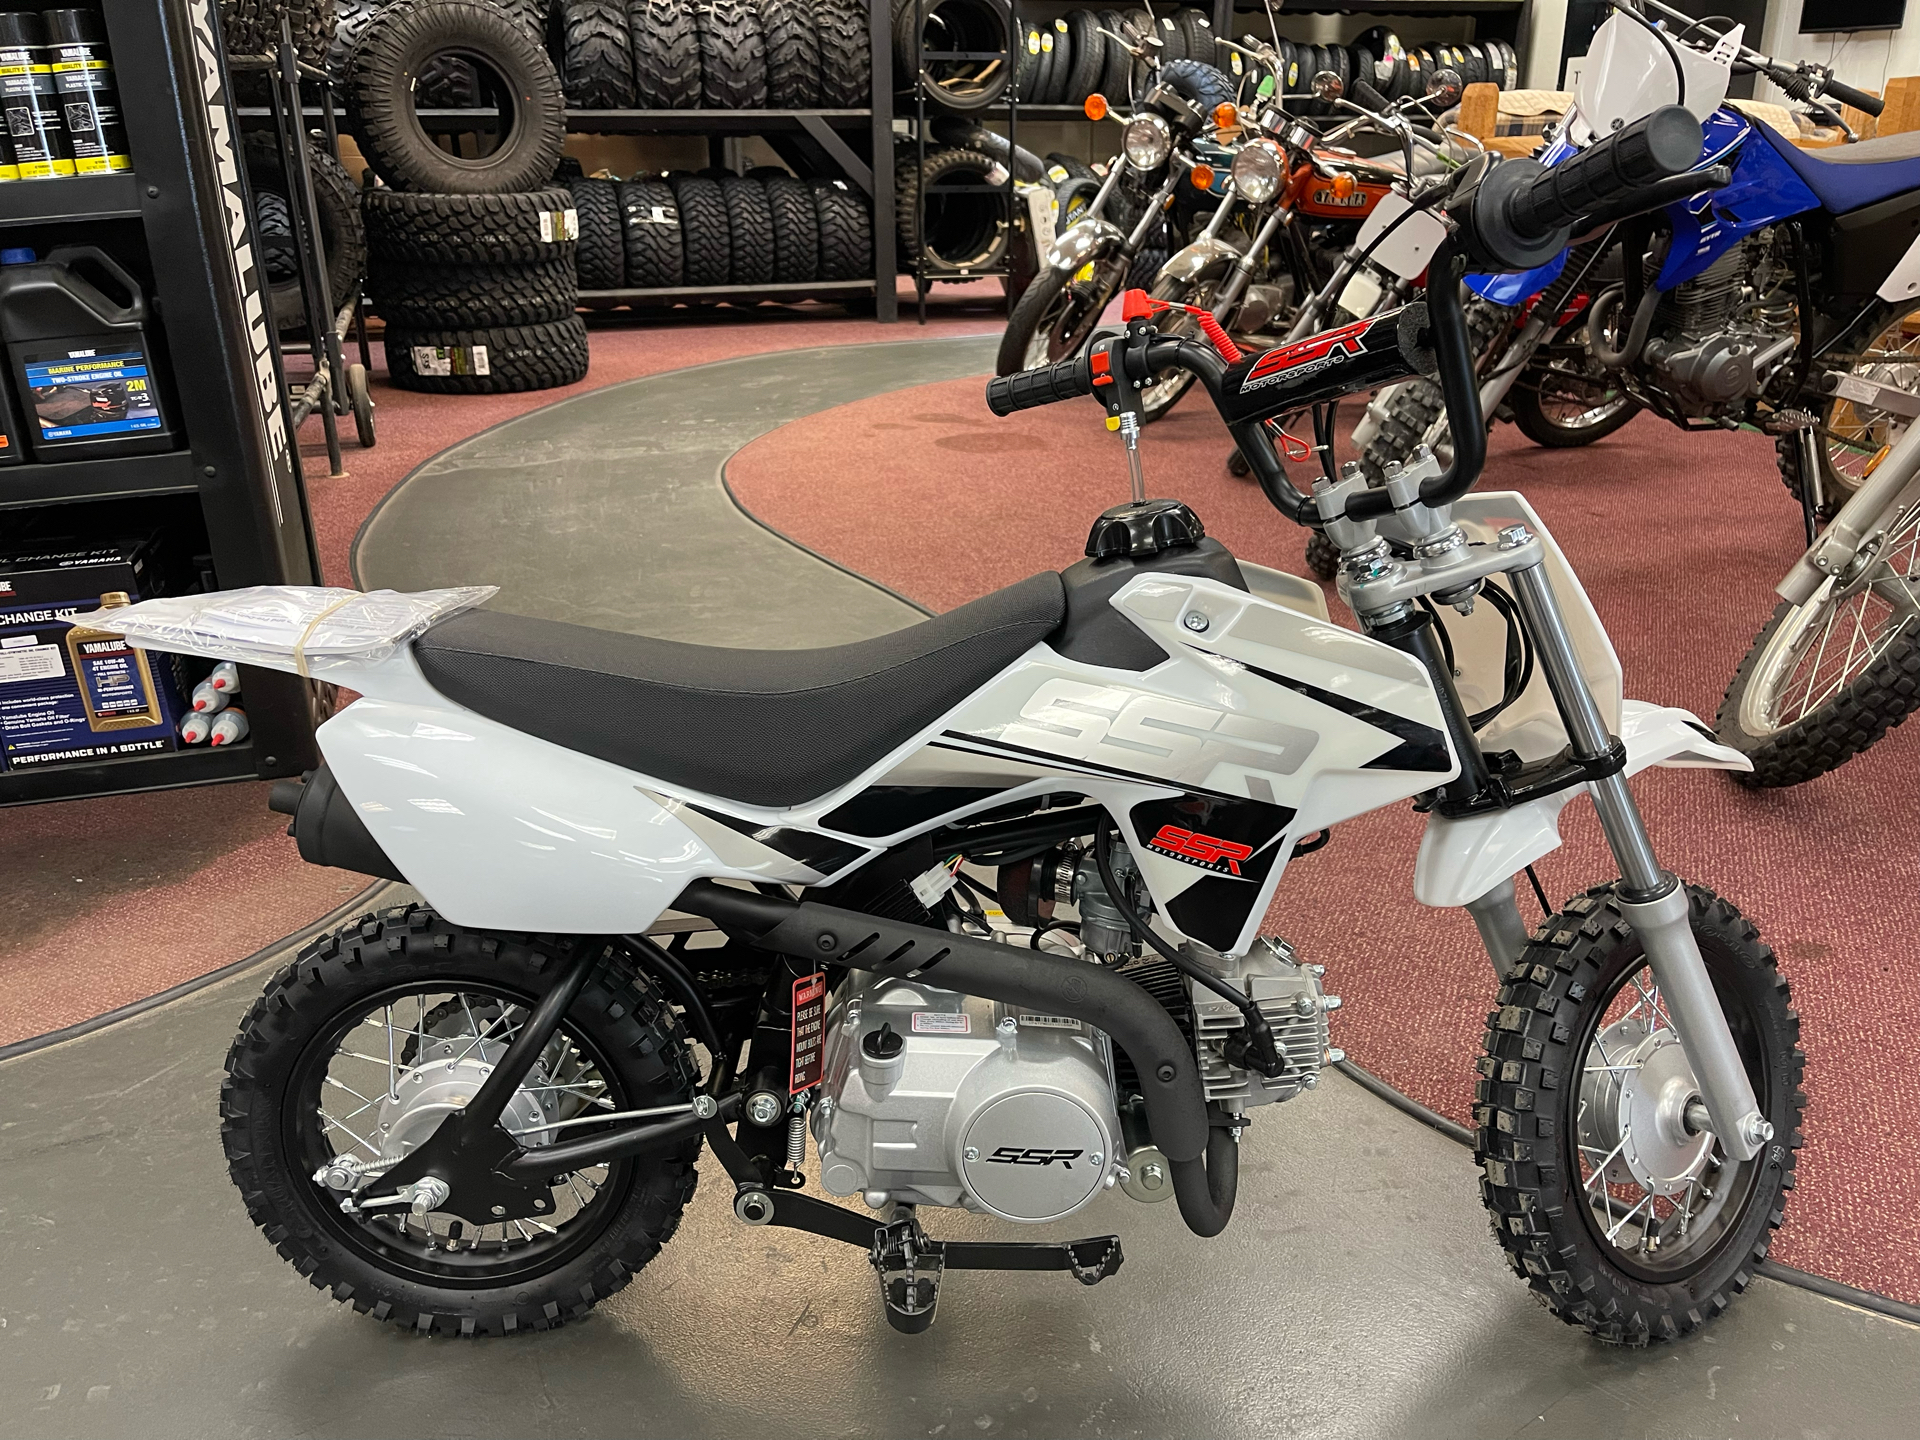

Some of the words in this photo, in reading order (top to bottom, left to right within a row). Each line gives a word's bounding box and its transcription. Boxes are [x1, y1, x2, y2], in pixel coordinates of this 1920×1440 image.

[192, 0, 288, 461] YAMALUBE
[1244, 315, 1379, 381] SSR
[48, 365, 75, 375] MARINE
[75, 360, 125, 372] PERFORMANCE
[1239, 355, 1345, 395] MOTORSPORTS
[51, 373, 91, 384] TWO-STROKE
[90, 371, 113, 380] ENGINE
[113, 370, 124, 378] OIL
[125, 379, 148, 392] 2M
[15, 551, 88, 562] CHANGE
[90, 548, 119, 556] KIT
[74, 556, 122, 565] YAMAHA
[0, 609, 54, 626] CHANGE
[54, 607, 78, 619] KIT
[83, 640, 127, 654] YAMALUBE
[31, 720, 53, 728] Gaskets
[998, 677, 1321, 805] SSR
[12, 748, 95, 765] PERFORMANCE
[96, 746, 108, 755] IN
[110, 745, 119, 753] A
[120, 740, 164, 752] BOTTLE
[1146, 843, 1230, 873] MOTORSPORTS
[1150, 824, 1254, 876] SSR
[798, 984, 822, 1002] WARNING
[797, 1009, 808, 1021] PLEASE
[808, 1007, 814, 1018] BE
[813, 1005, 821, 1016] SURE
[797, 1026, 805, 1037] THAT
[810, 1020, 821, 1033] ENGINE
[796, 1039, 808, 1053] MOUNT
[804, 1052, 816, 1065] BEFORE
[985, 1146, 1085, 1170] SSR
